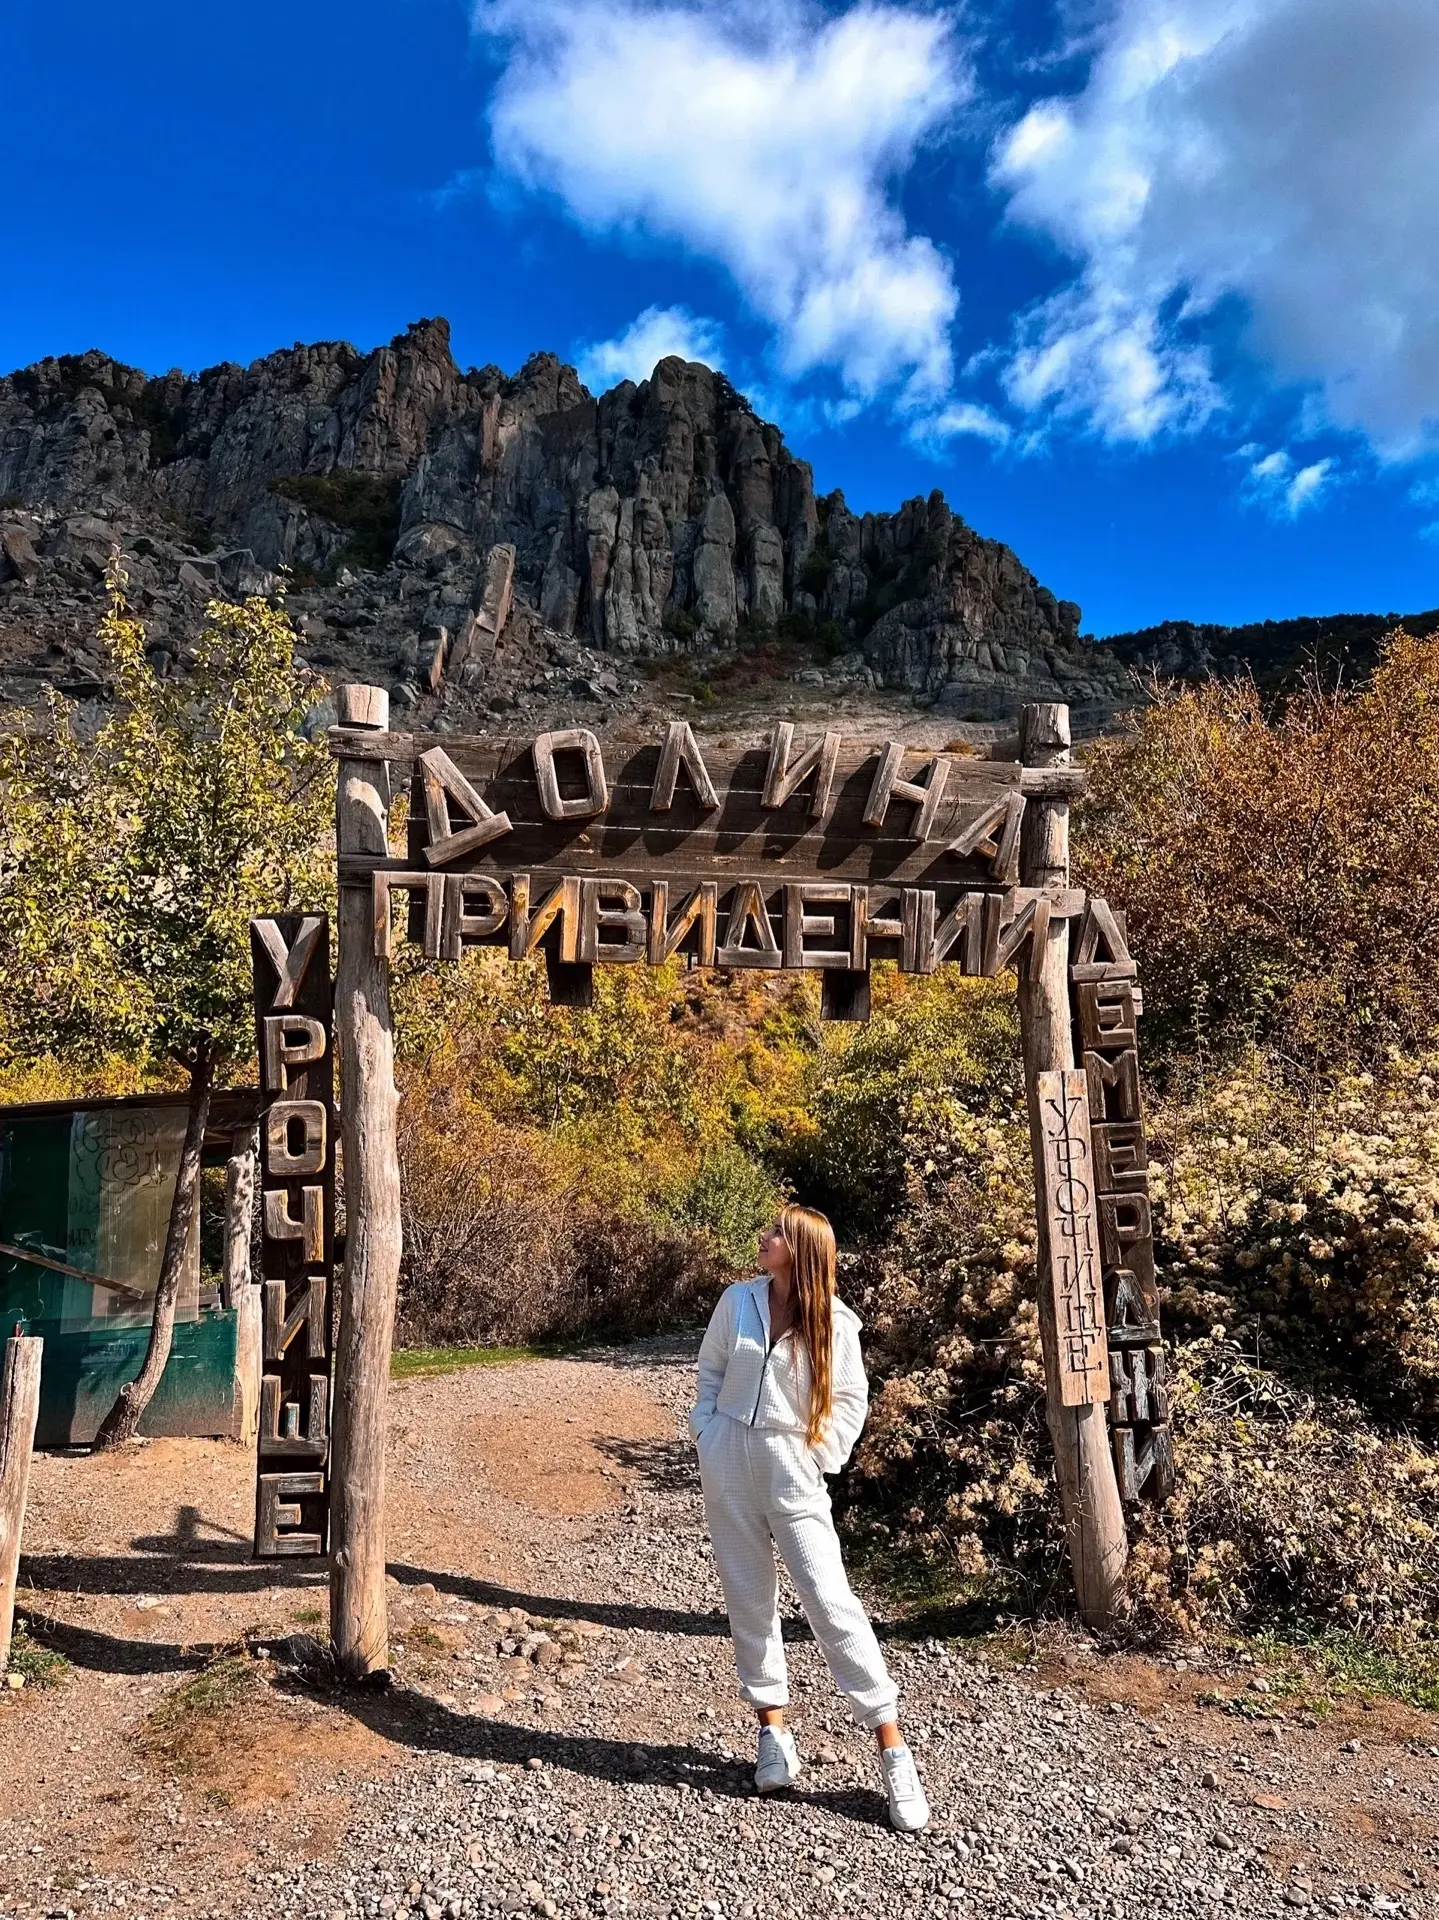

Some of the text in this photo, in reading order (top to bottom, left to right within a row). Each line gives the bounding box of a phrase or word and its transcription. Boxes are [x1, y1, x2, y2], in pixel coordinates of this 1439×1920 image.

[418, 721, 1027, 884] ДОЛИНА
[250, 915, 329, 1556] УРОЧИЩЕ
[1044, 1096, 1103, 1374] УРОЧИЩЕ
[1070, 898, 1175, 1502] ДЕМЕРДЖИ
